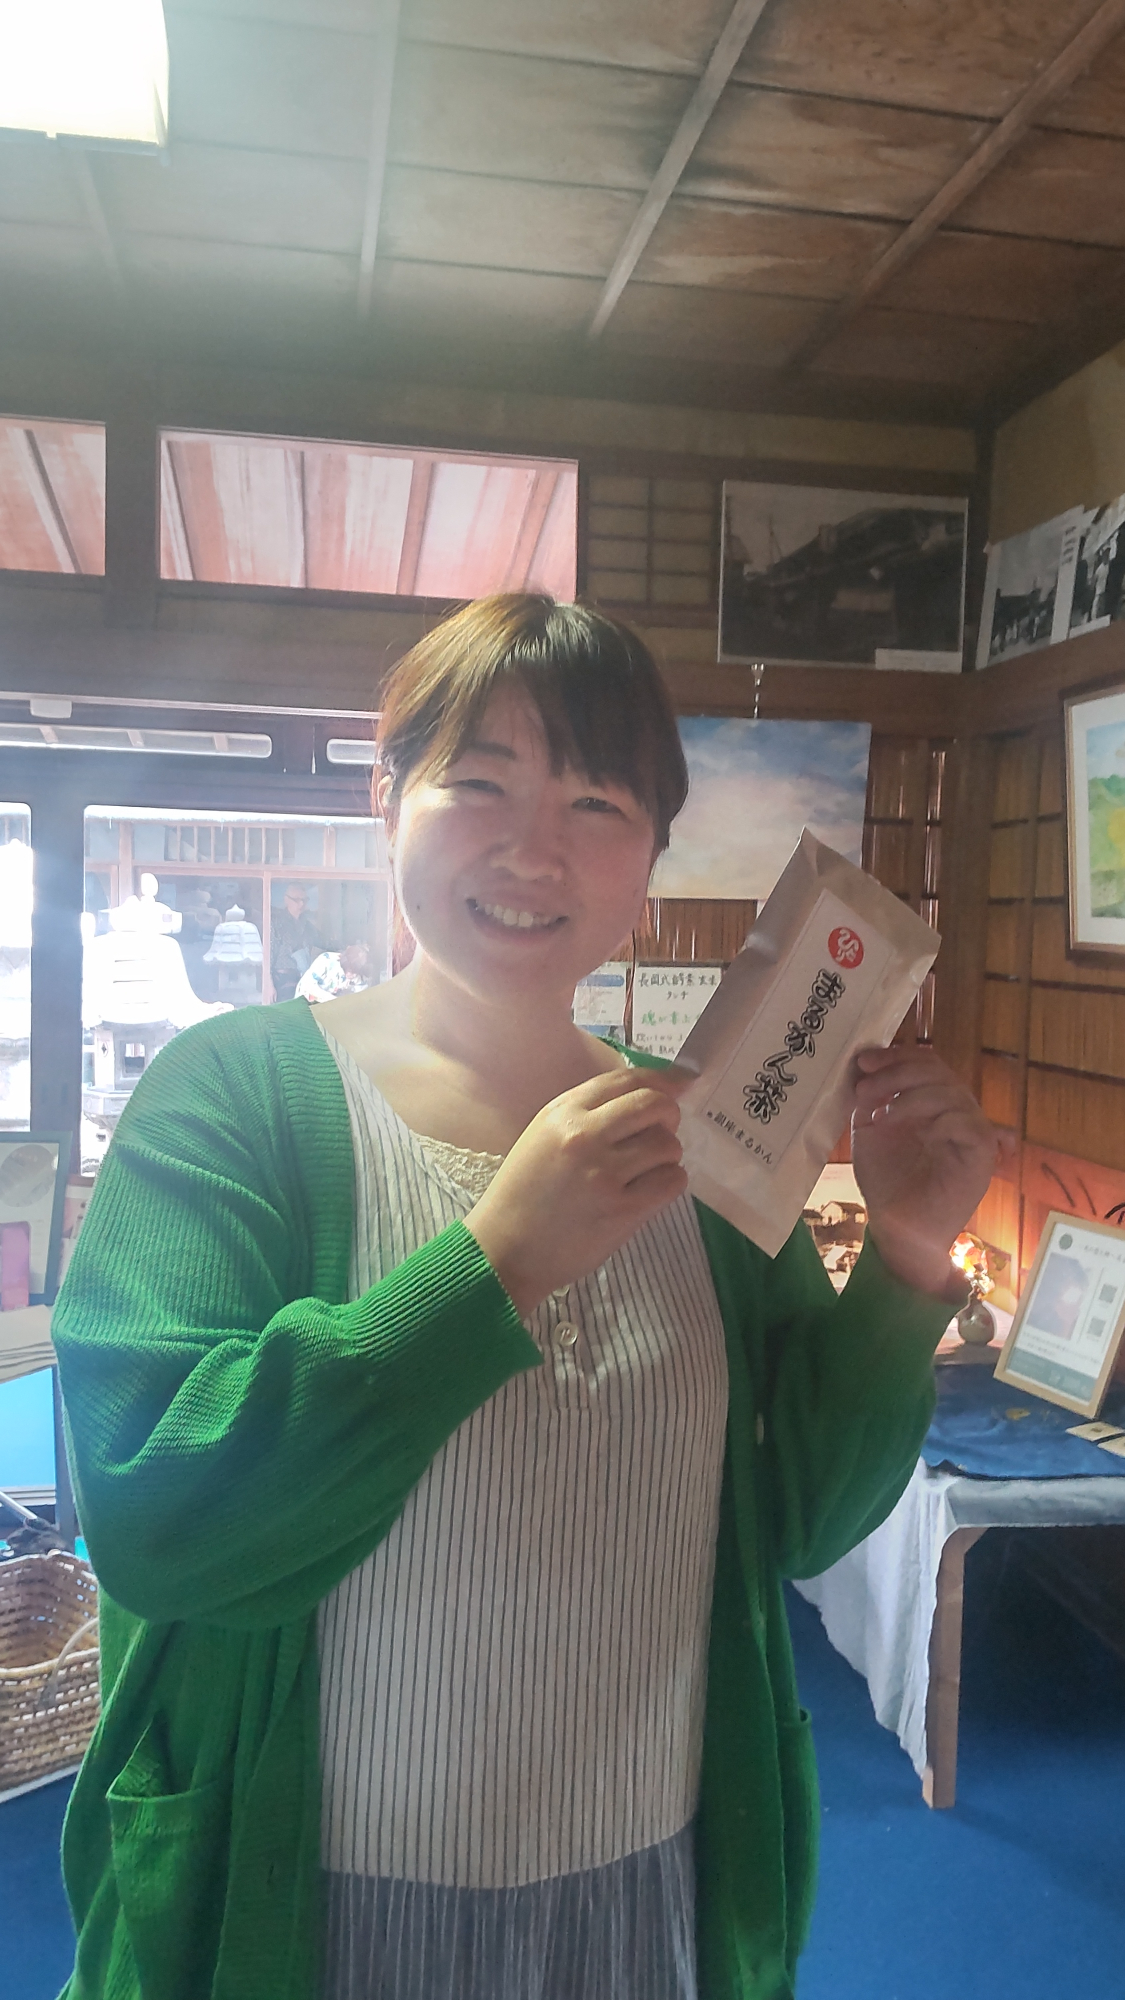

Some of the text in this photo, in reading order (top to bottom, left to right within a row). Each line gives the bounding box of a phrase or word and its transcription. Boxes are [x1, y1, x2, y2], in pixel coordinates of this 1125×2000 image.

[743, 968, 846, 1124] まるかん茶
